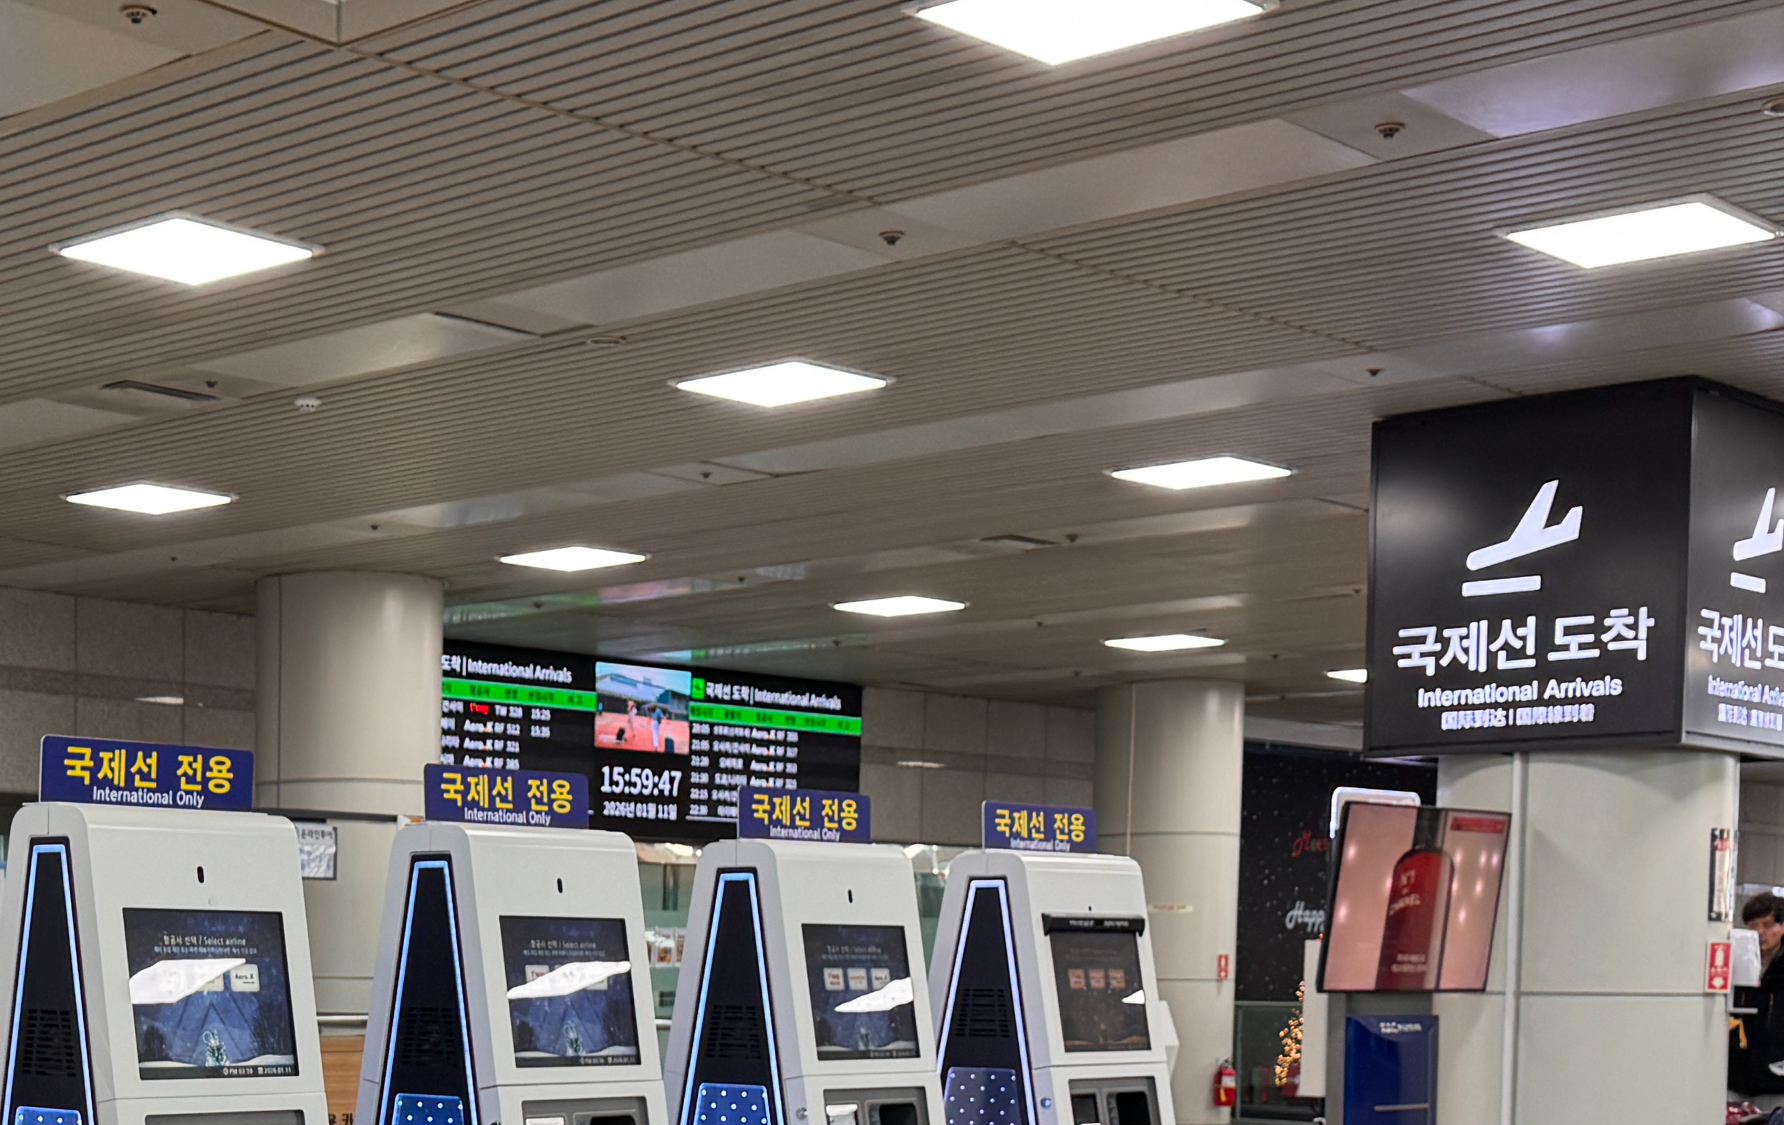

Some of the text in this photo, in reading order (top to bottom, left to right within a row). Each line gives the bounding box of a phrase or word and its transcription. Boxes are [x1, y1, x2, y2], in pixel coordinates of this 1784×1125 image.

[1392, 606, 1655, 676] 국제선 도착
[1698, 608, 1763, 670] 국제선
[468, 658, 534, 680] International
[534, 665, 573, 684] Arrivals
[754, 688, 809, 706] International
[810, 693, 842, 711] Arrivals
[1418, 675, 1623, 708] International Arrivals
[1708, 675, 1762, 703] International
[64, 746, 234, 794] 국제선 전용
[600, 765, 682, 797] 15:59:47
[93, 786, 204, 808] International Only
[441, 772, 573, 814] 국제선 전용
[464, 807, 551, 826] International Only
[603, 800, 635, 818] 2026년
[752, 794, 858, 831] 국제선 전용
[770, 824, 840, 843] International Only
[995, 809, 1085, 842] 국제선 전용
[1010, 838, 1070, 852] International Only
[203, 935, 223, 946] Select
[225, 936, 246, 947] airline
